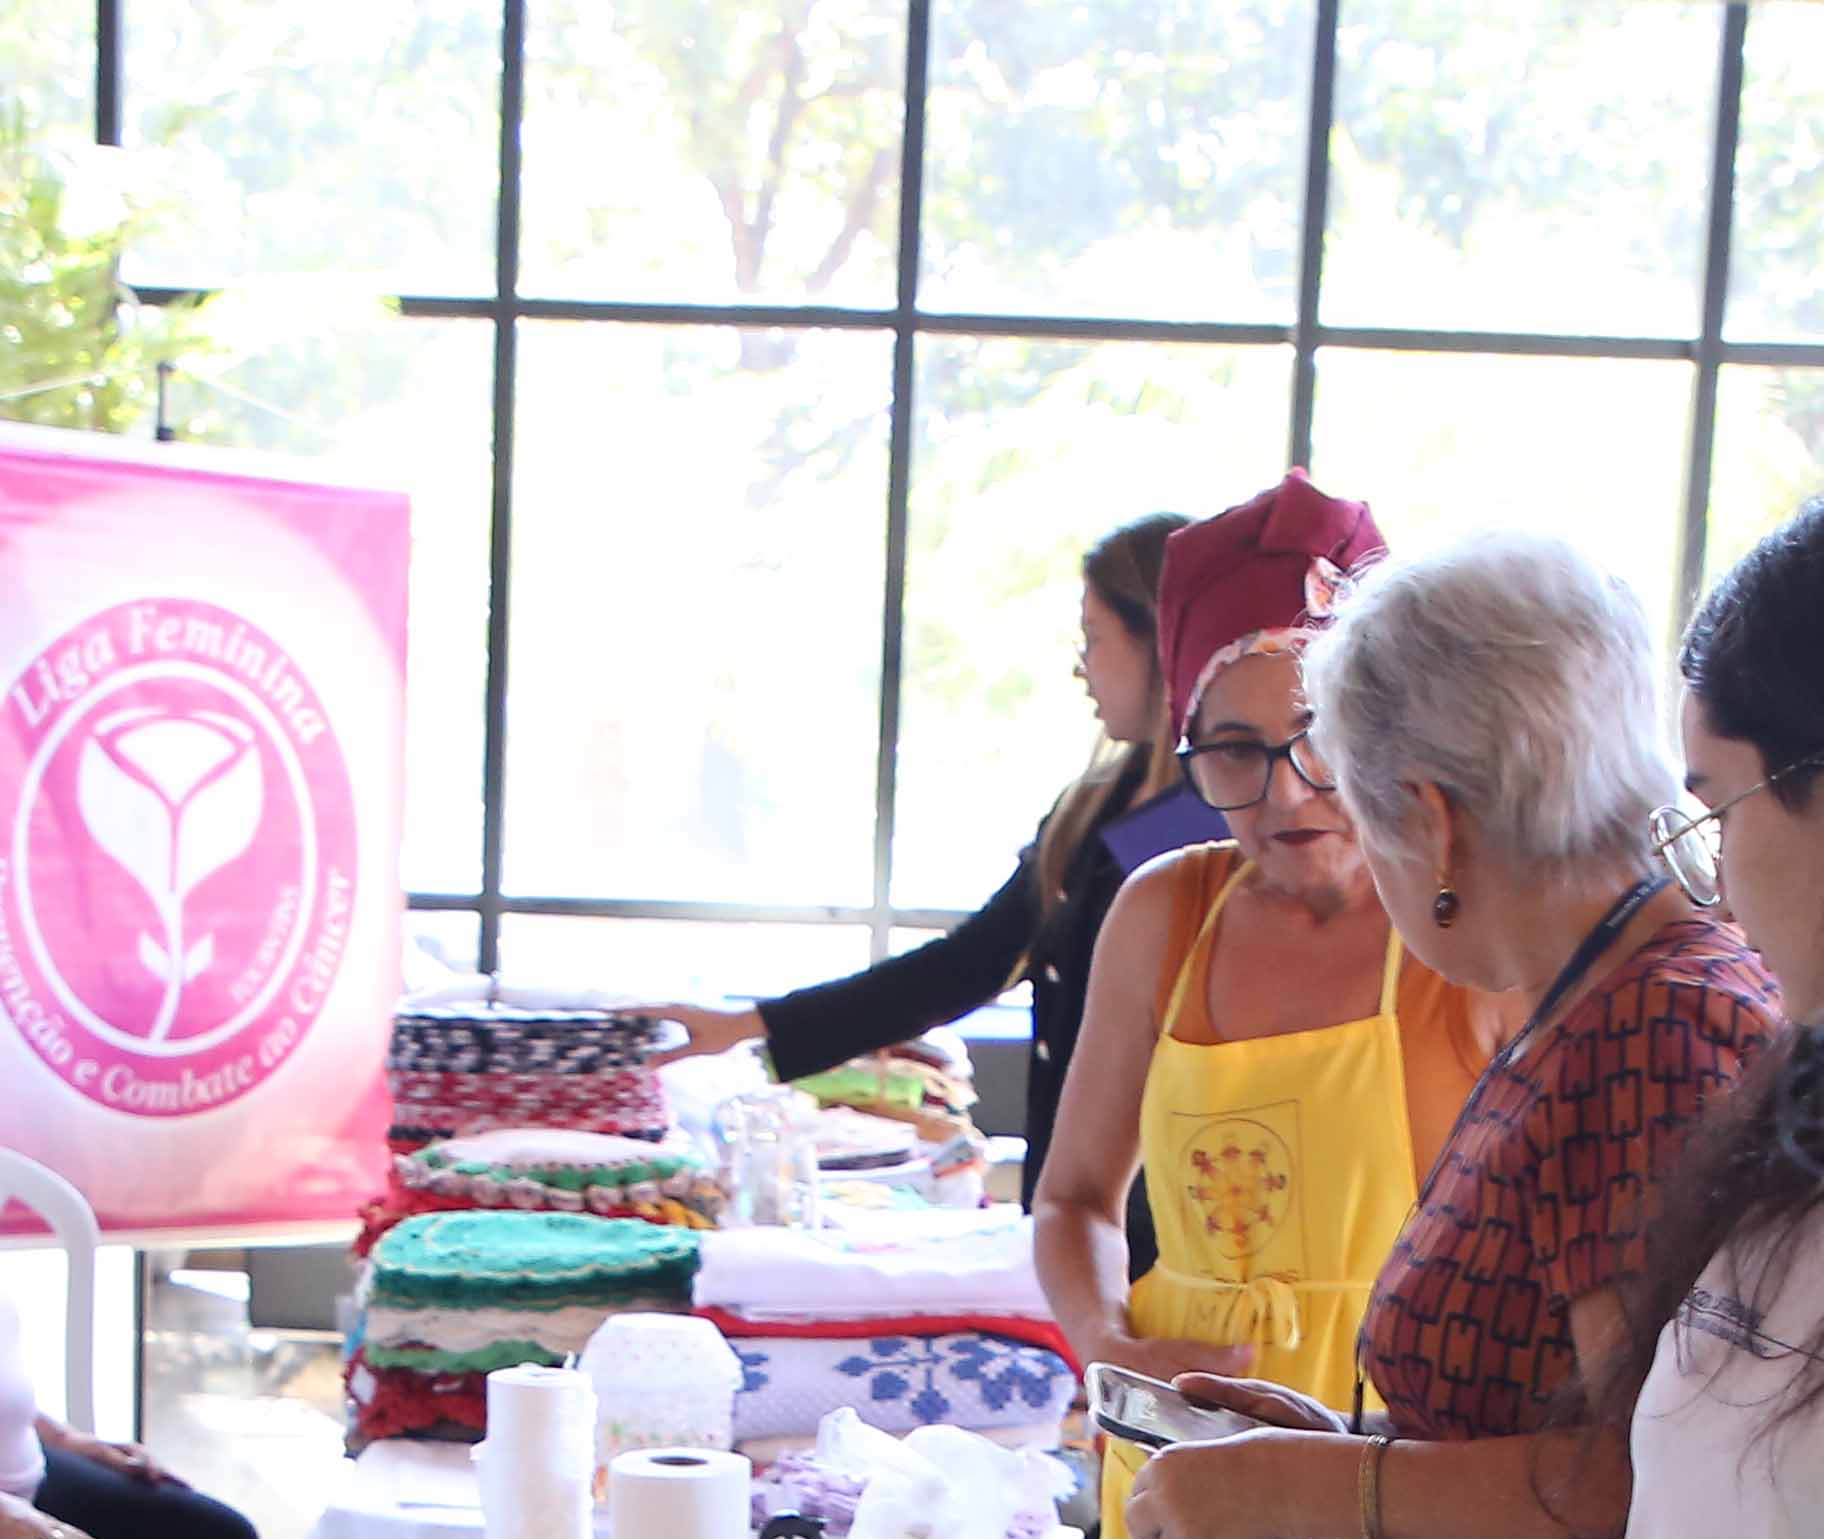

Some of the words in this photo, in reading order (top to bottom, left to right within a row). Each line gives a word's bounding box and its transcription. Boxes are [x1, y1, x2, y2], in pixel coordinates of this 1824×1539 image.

[12, 625, 116, 729] Liga
[130, 606, 326, 746] Feminina
[72, 1058, 101, 1086] e
[100, 1055, 256, 1110] Combate
[258, 1016, 298, 1069] ao
[289, 866, 351, 1015] Câncer
